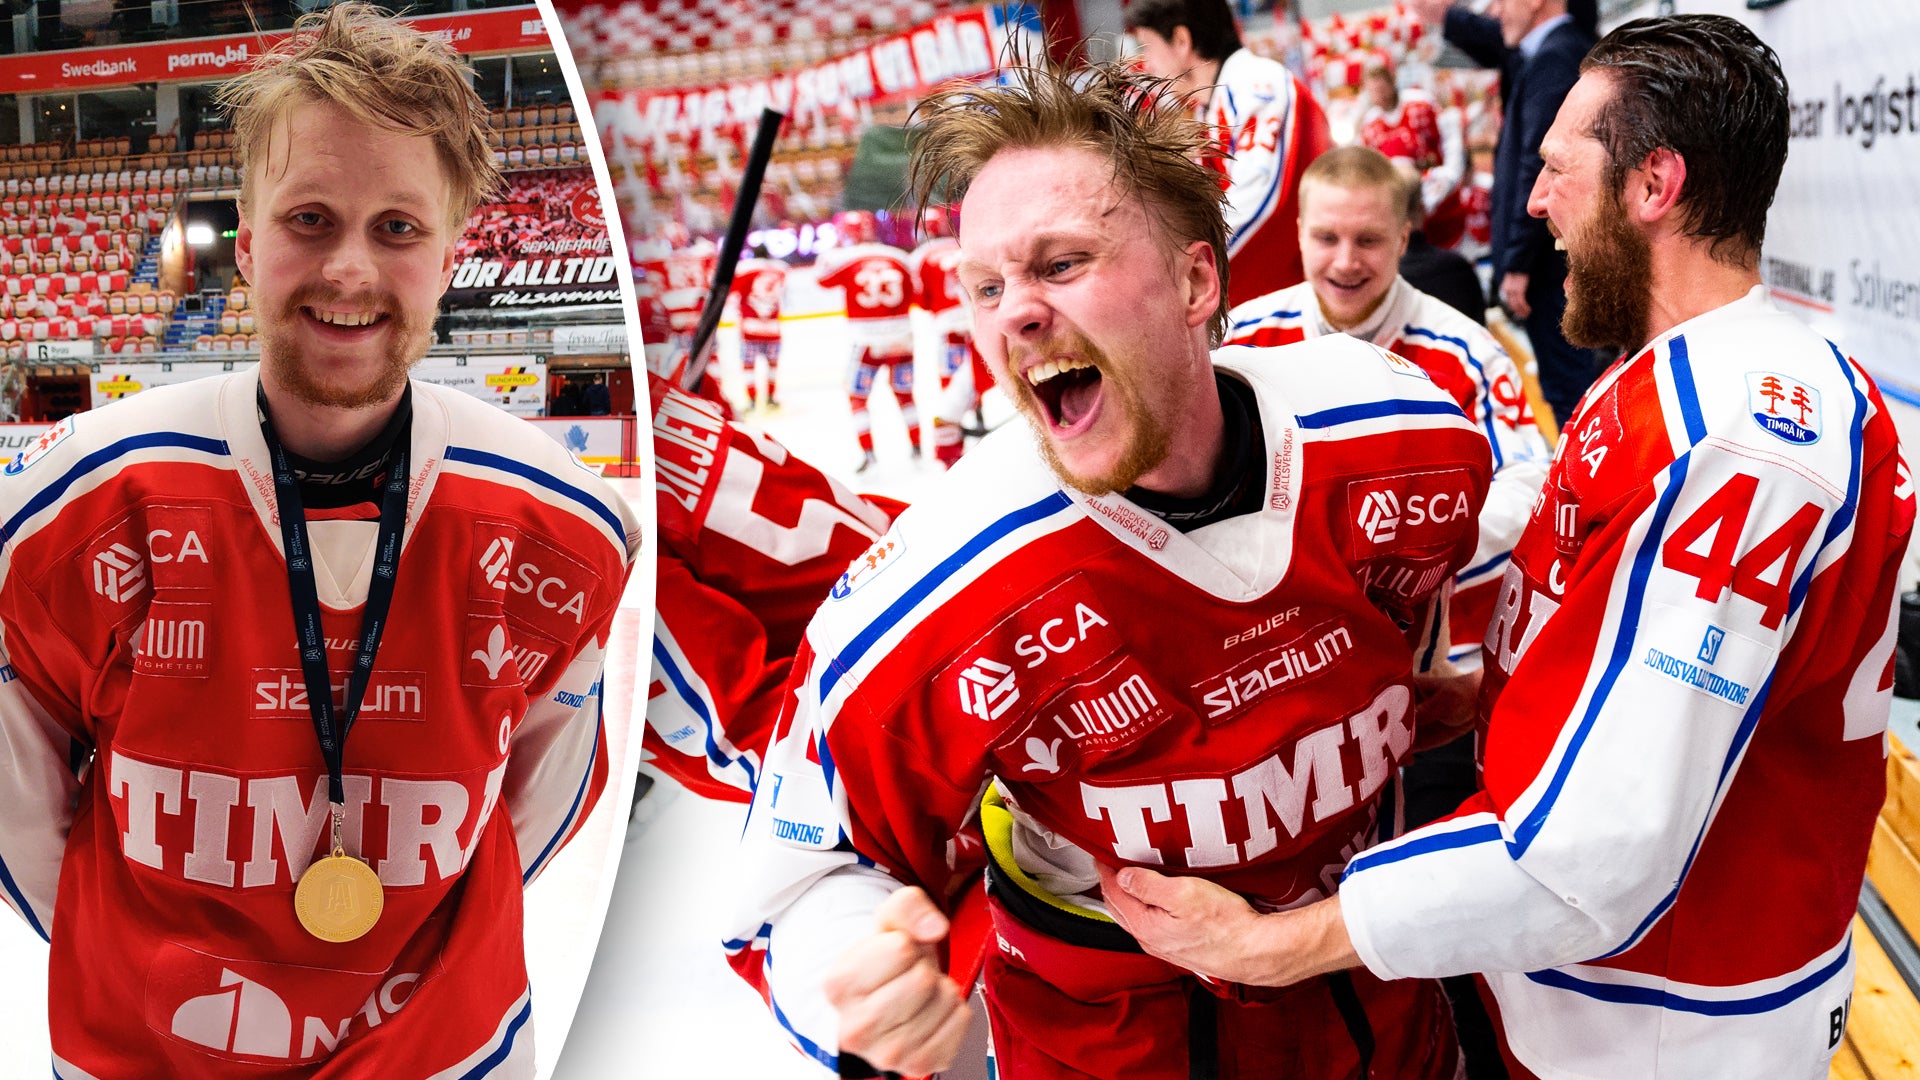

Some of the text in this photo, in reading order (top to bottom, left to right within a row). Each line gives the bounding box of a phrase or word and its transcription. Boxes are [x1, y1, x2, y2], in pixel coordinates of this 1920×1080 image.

[61, 58, 136, 78] Swedbank
[168, 44, 247, 71] permobil
[502, 256, 615, 286] ALLTID
[853, 266, 903, 308] 33
[1795, 428, 1806, 440] IK
[1272, 452, 1283, 490] HOCKEY
[1282, 428, 1293, 491] ALLSVENSKAN
[240, 458, 277, 511] ALLSVENSKAN
[408, 458, 436, 511] ALLSVENSKAN
[1086, 498, 1148, 541] ALLSVENSKAN
[1116, 504, 1153, 531] HOCKEY
[1405, 491, 1469, 526] SCA
[1662, 472, 1825, 631] 44
[509, 562, 585, 625] SCA
[1014, 602, 1109, 669] SCA
[1223, 606, 1301, 650] BAUER
[1203, 626, 1353, 719] stadium
[255, 675, 421, 713] stadum
[1053, 674, 1159, 739] LILIUM
[1077, 708, 1165, 749] FASTIGHETER
